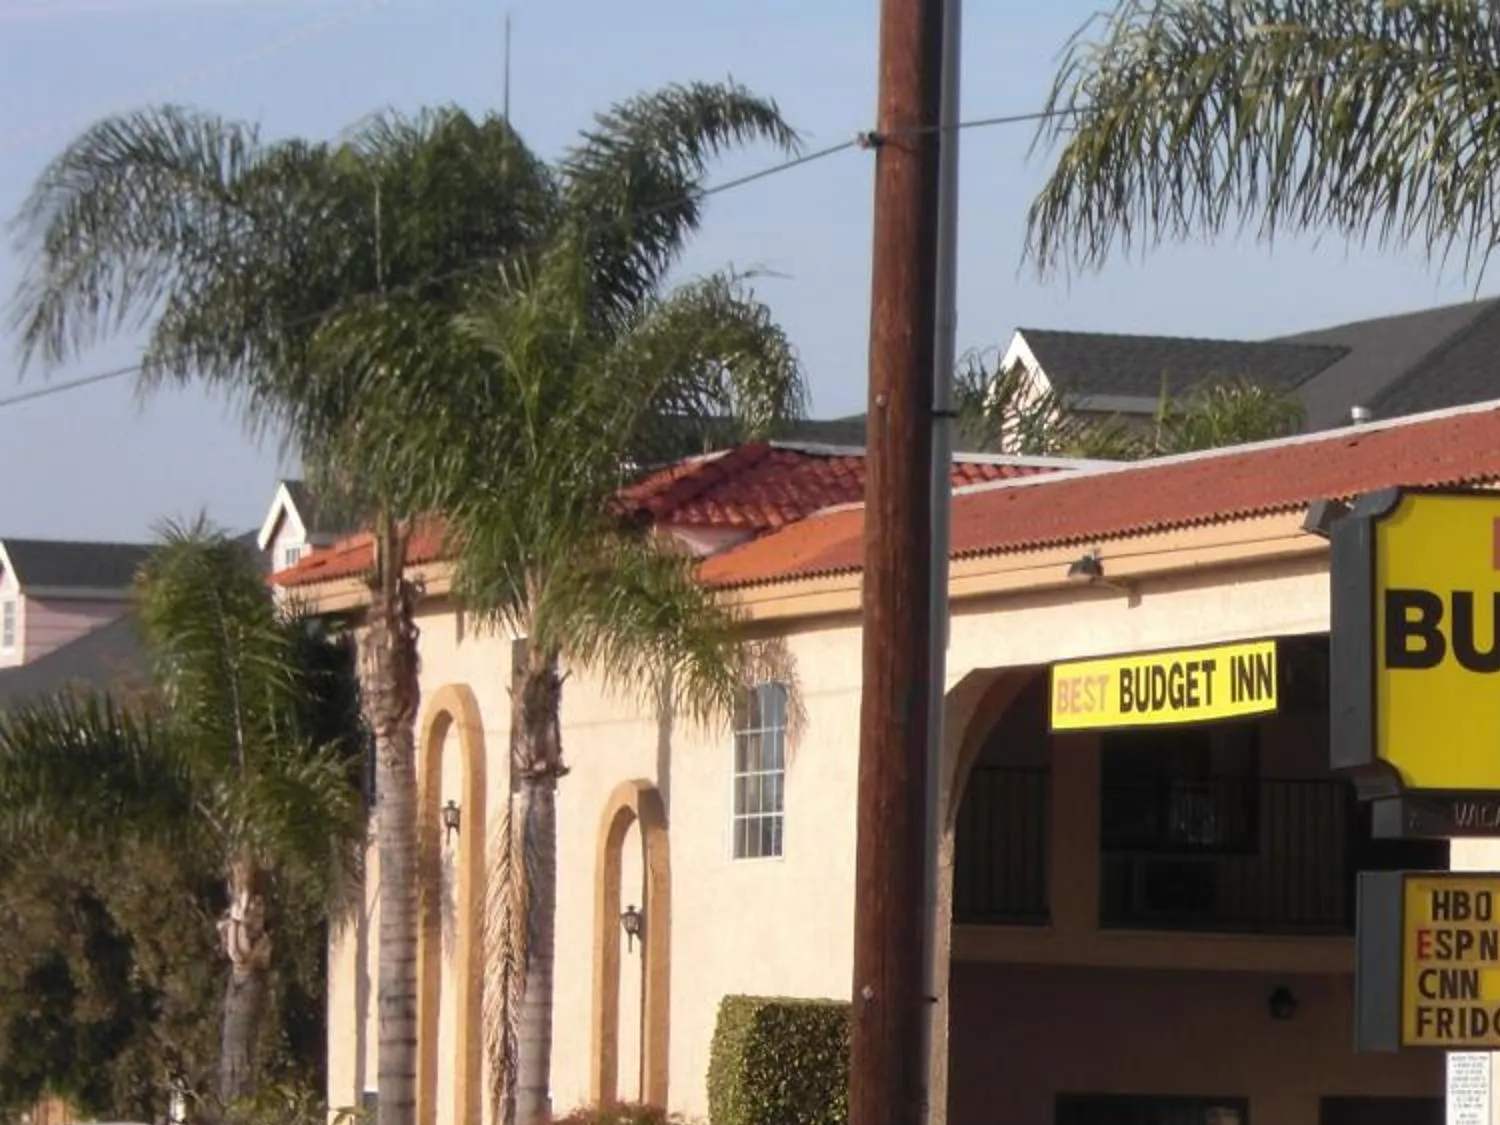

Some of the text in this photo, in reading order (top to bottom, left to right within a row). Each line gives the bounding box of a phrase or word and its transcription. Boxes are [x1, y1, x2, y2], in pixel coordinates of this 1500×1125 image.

[1056, 651, 1273, 714] BEST BUDGET INN
[1431, 889, 1493, 922] HBO
[1416, 929, 1499, 961] ESPN
[1418, 968, 1480, 1000] CNN
